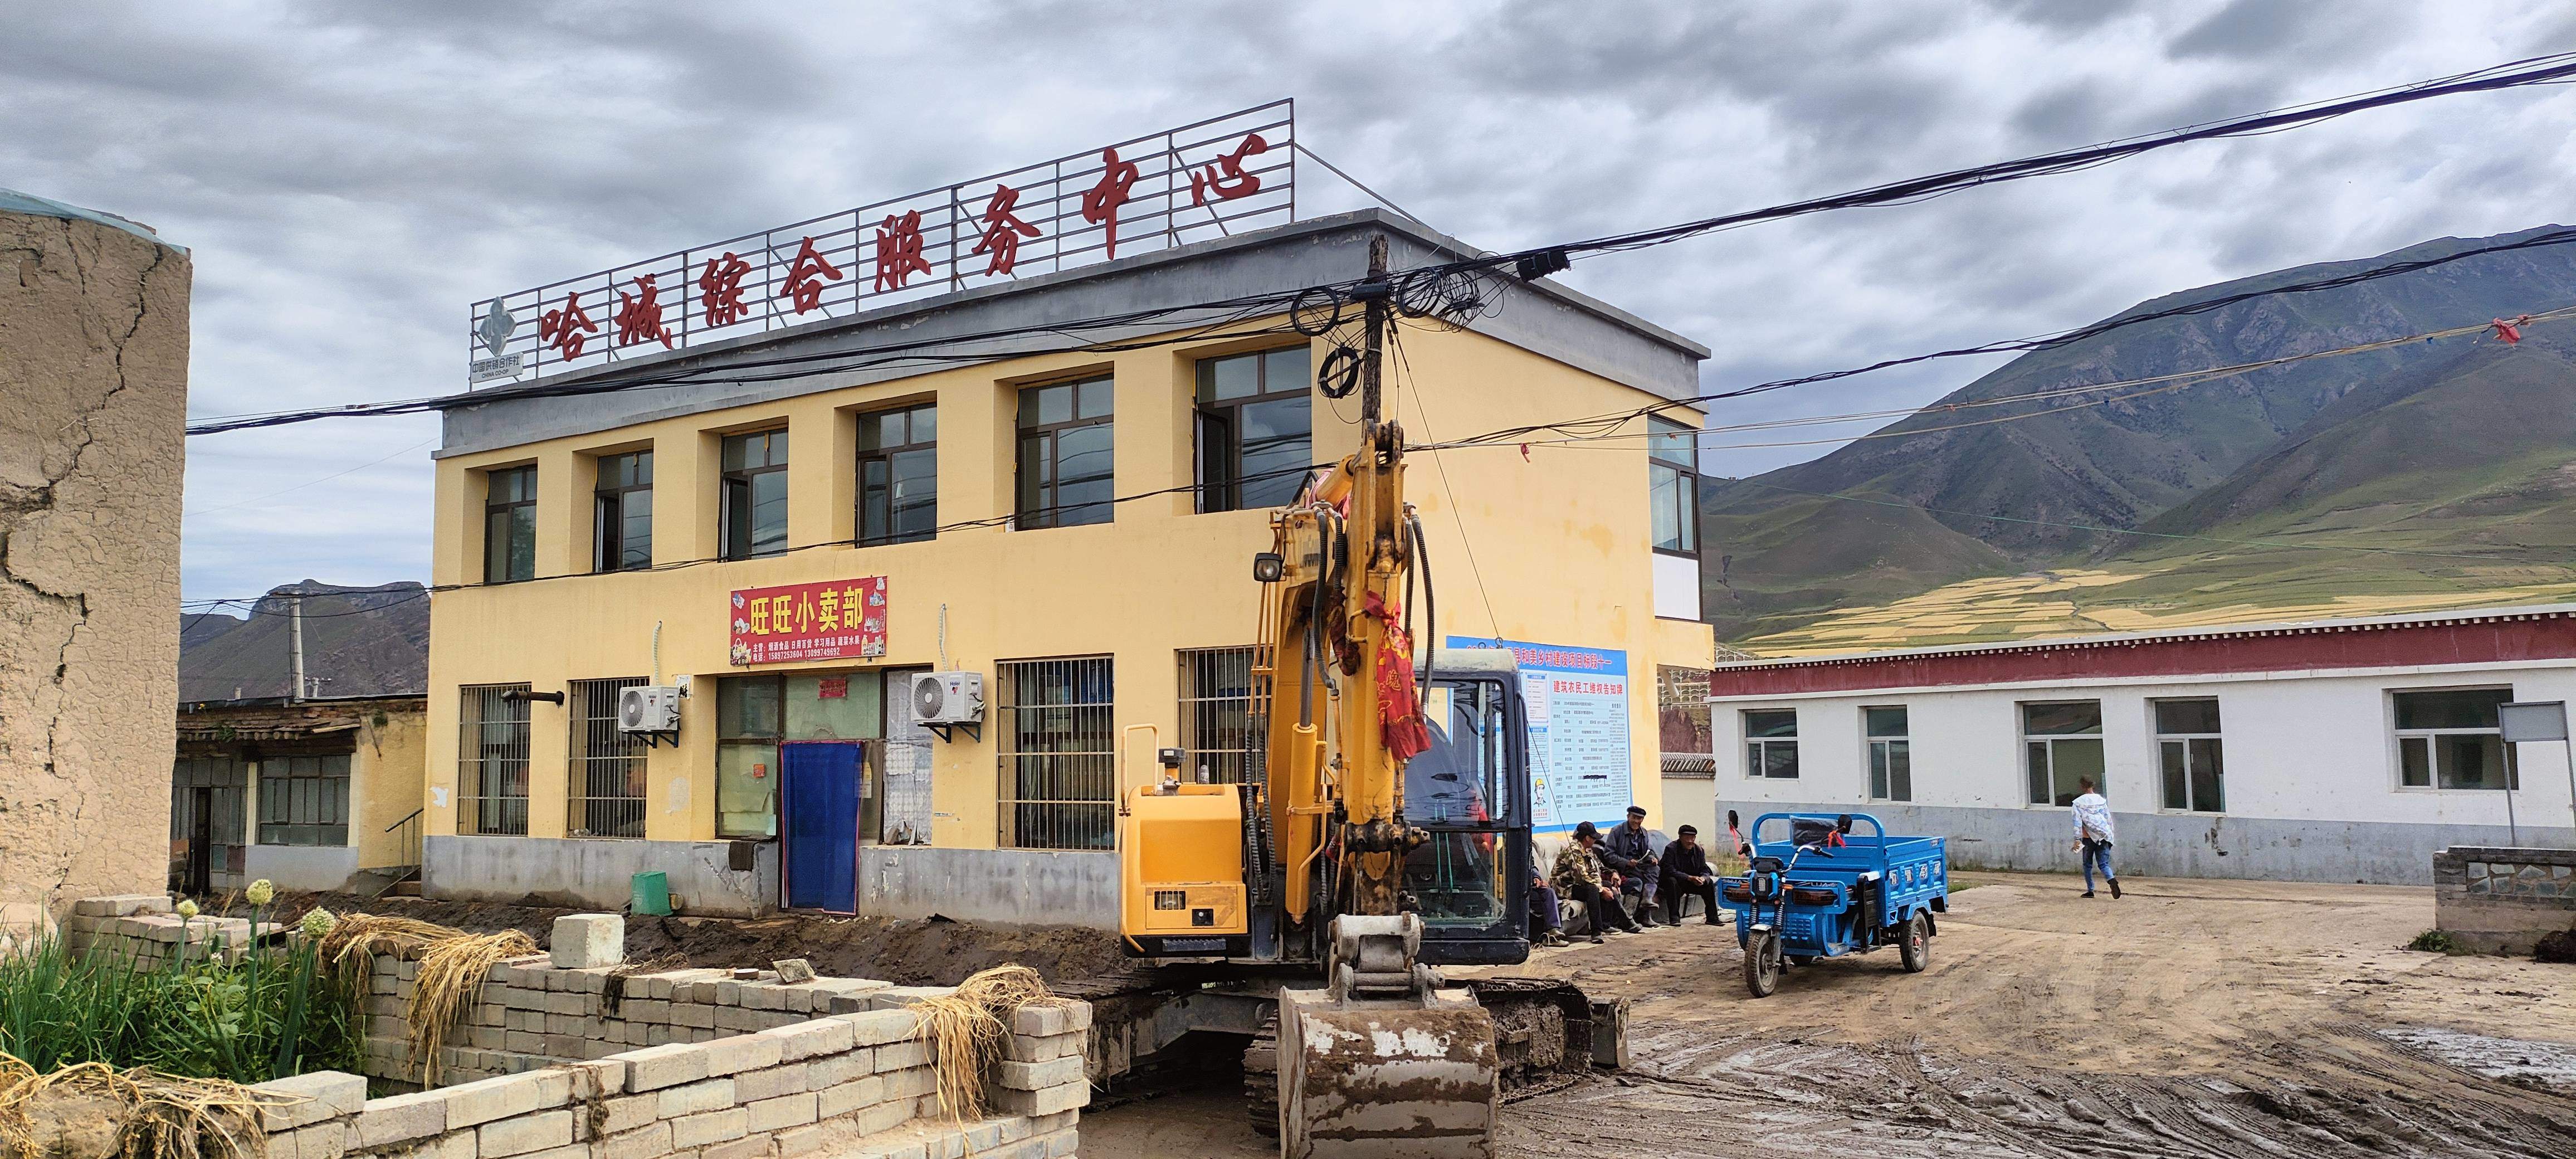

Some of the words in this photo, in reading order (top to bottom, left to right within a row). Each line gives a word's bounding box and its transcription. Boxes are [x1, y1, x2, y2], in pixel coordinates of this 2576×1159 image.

[540, 133, 1268, 362] 哈城综合服务中心
[472, 355, 520, 373] 中国供销合作社
[750, 586, 864, 635] 旺旺小卖部
[768, 641, 789, 651] 烟酒食品
[791, 639, 813, 649] 日用百货
[814, 637, 836, 648] 学习用品
[837, 635, 860, 646] 蔬菜水果
[768, 650, 803, 660] 15897253604
[804, 647, 840, 658] 13099749692
[1553, 680, 1623, 696] 建筑农民工维权告知牌
